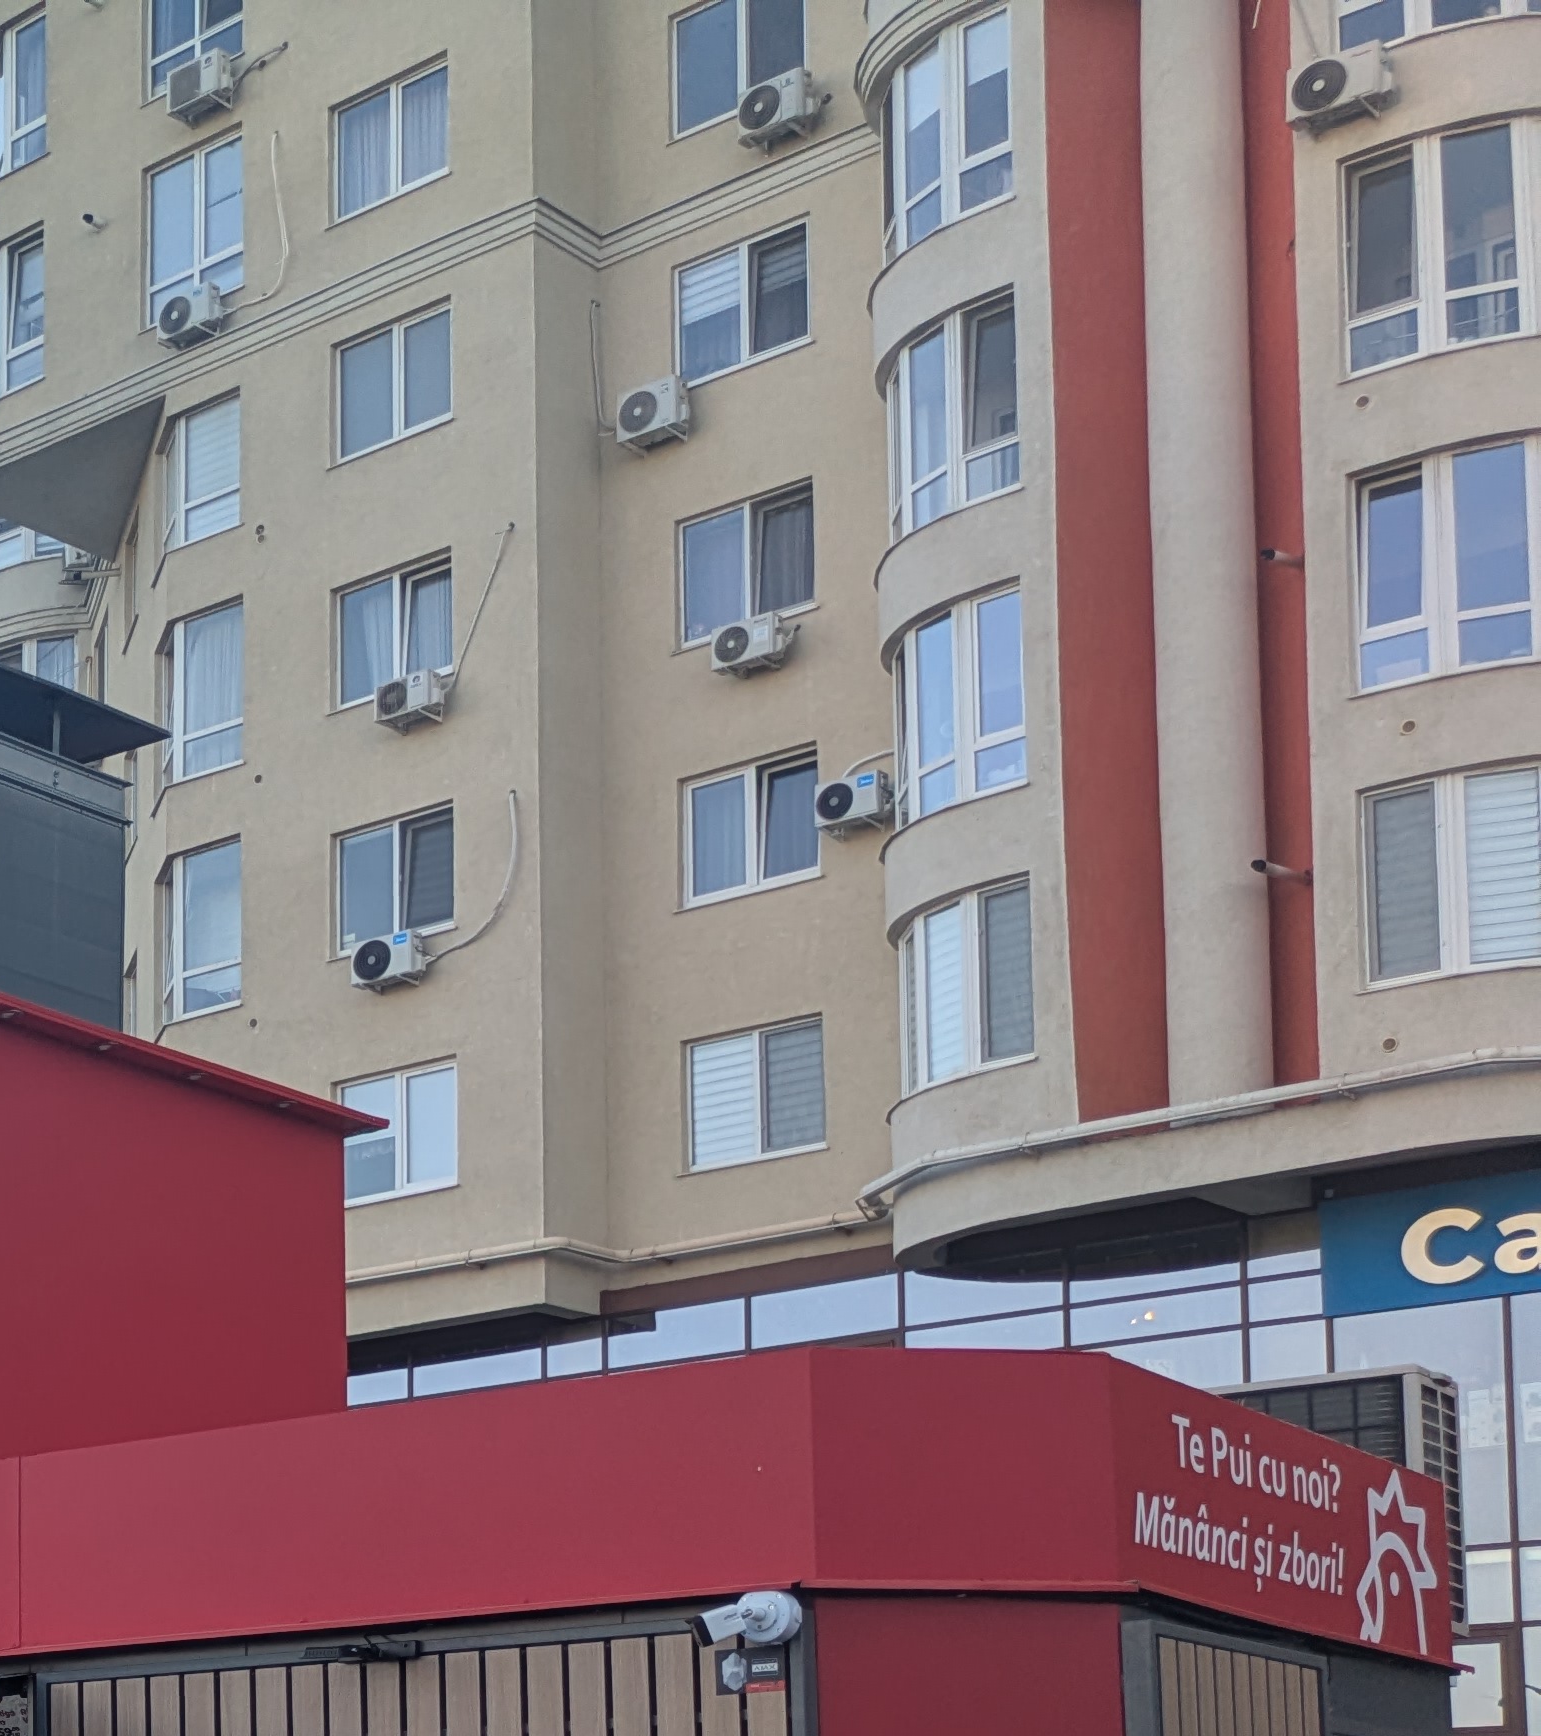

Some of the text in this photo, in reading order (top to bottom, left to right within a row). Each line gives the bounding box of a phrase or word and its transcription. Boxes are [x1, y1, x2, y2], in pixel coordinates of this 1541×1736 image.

[1172, 1413, 1341, 1514] Te Pui cu noi?
[1134, 1491, 1345, 1596] Mănânci și zbori!
